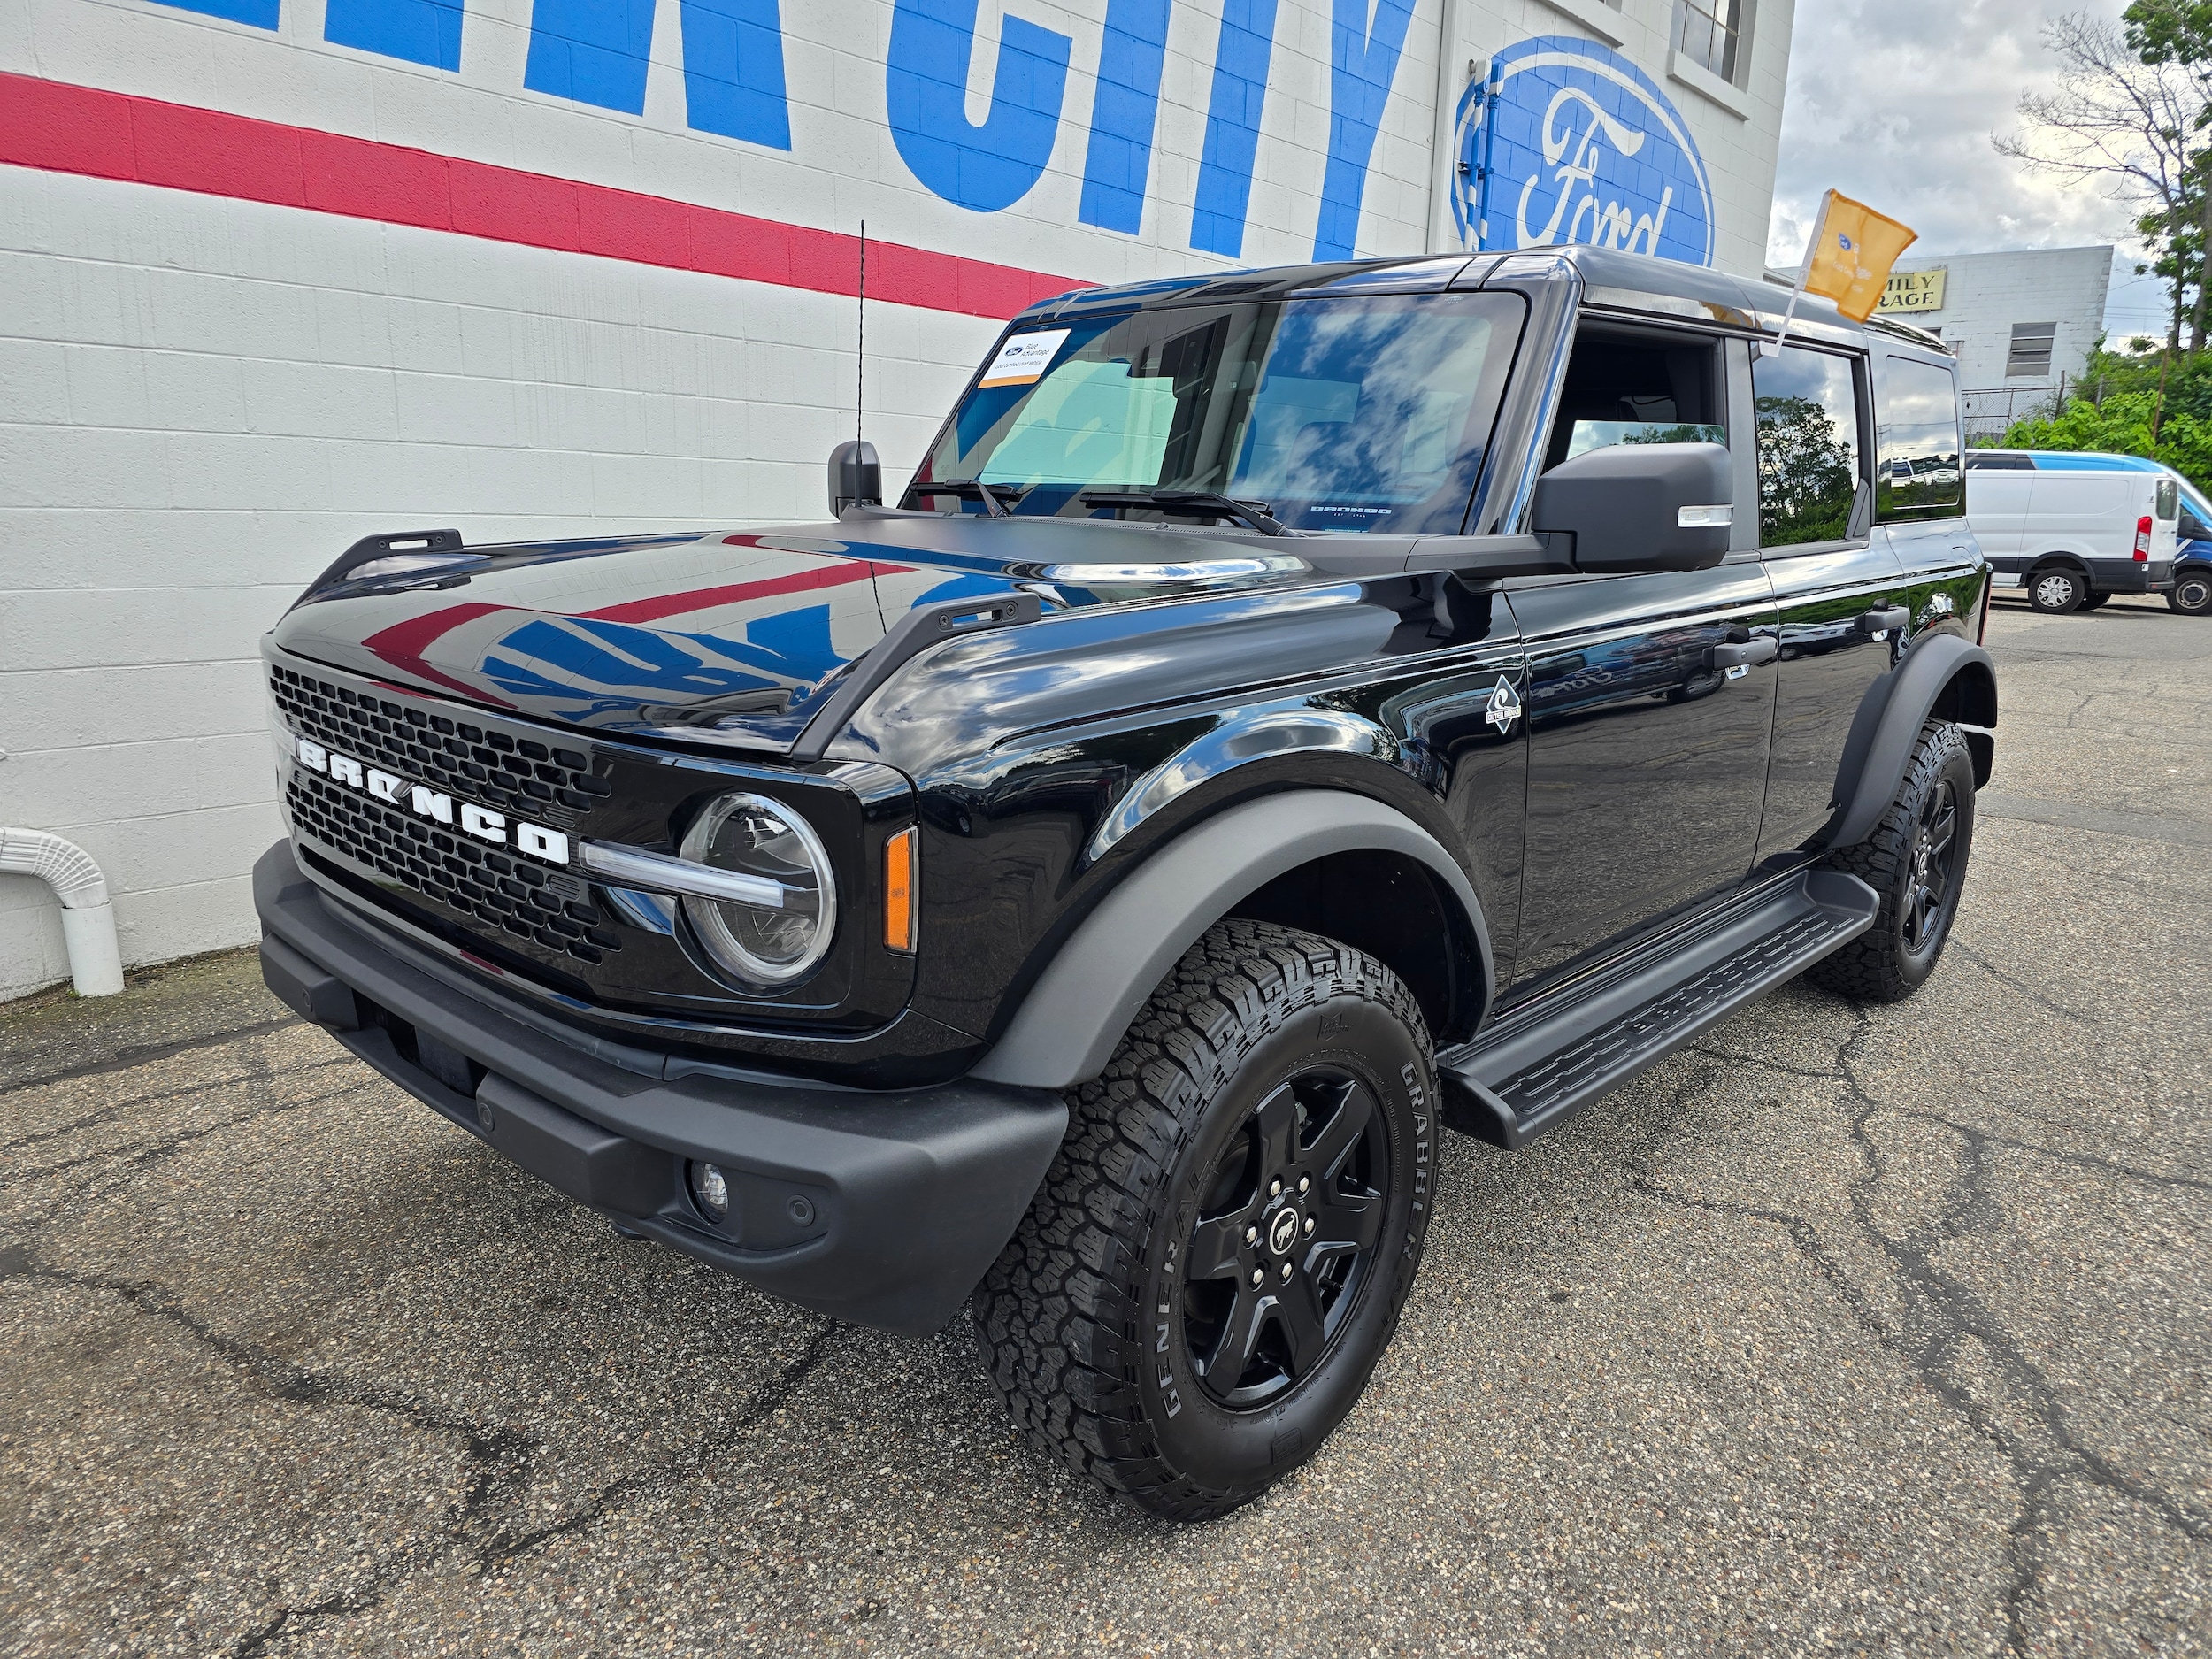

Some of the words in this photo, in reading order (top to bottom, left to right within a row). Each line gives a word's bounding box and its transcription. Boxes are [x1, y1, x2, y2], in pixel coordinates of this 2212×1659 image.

[1516, 86, 1674, 257] Ford
[299, 739, 570, 864] BRONCO
[1400, 1061, 1429, 1261] GRABBER
[1156, 1160, 1210, 1419] GENERAL
